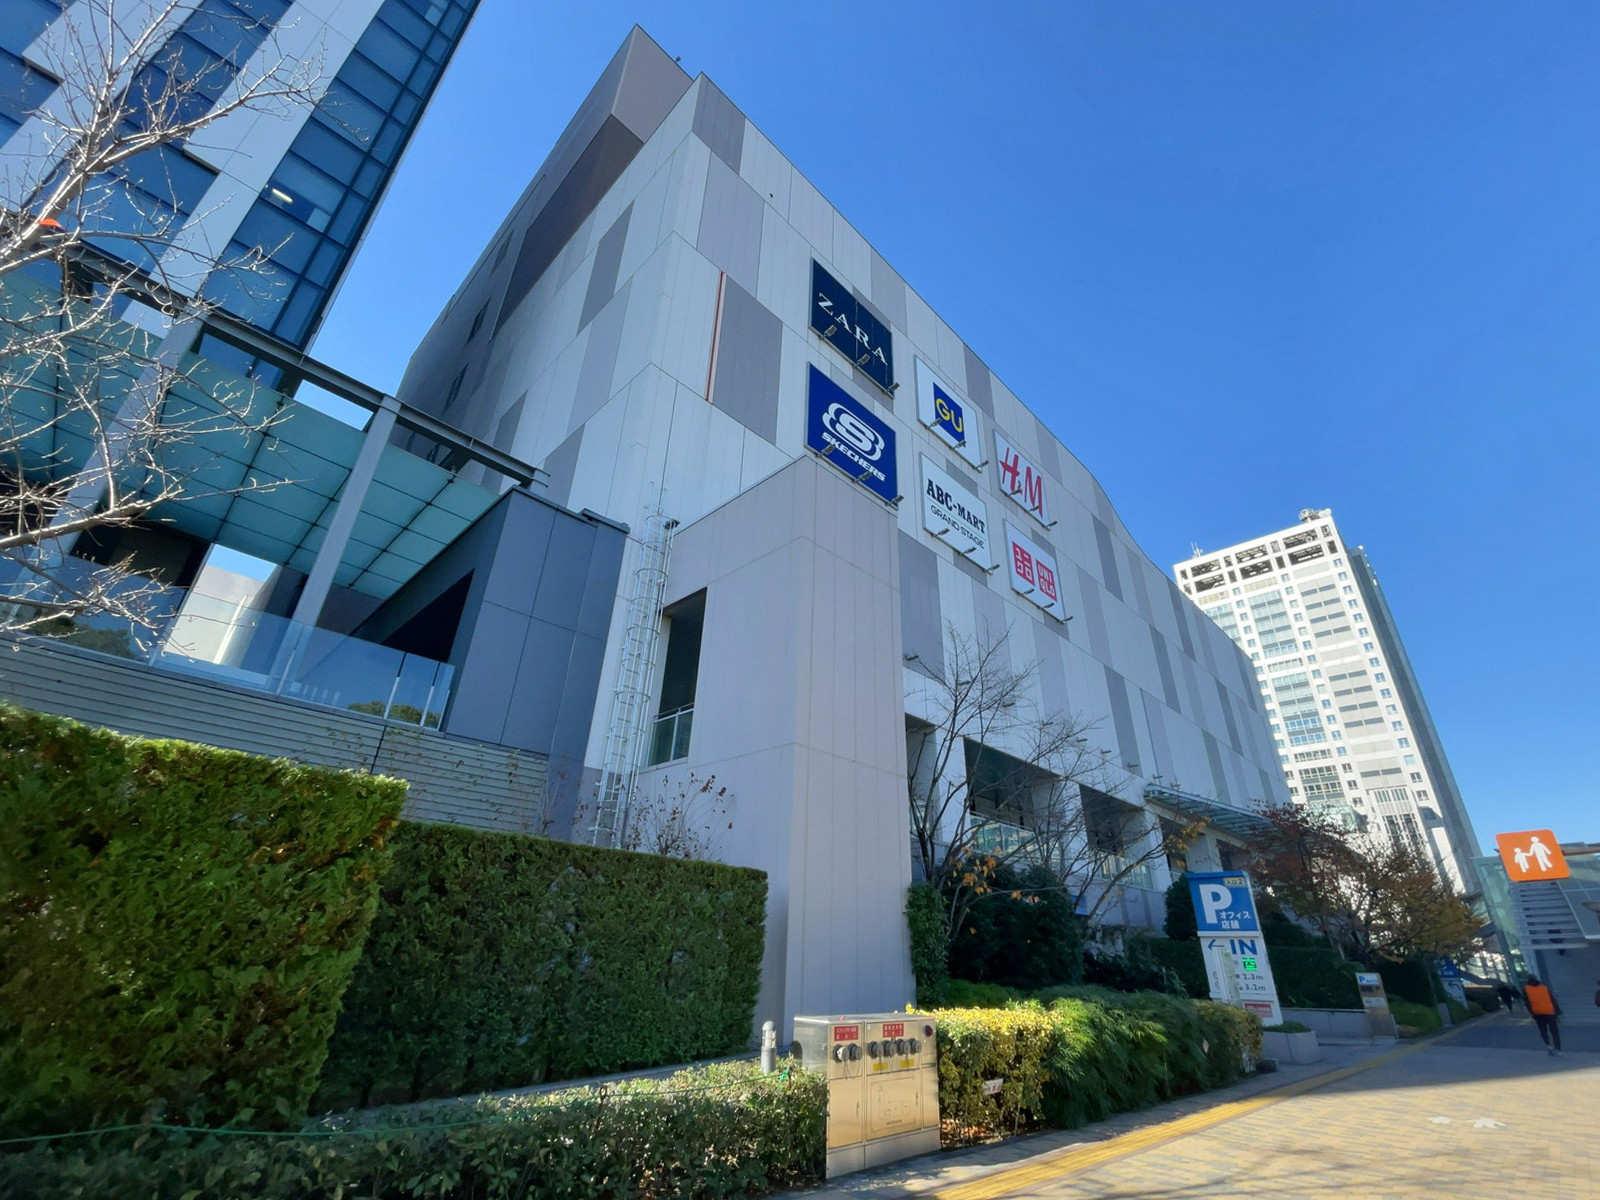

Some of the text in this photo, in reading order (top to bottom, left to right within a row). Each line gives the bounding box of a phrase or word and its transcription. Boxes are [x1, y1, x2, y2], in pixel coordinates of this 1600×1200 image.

[817, 292, 889, 366] ZARA
[935, 398, 963, 433] GU
[821, 431, 886, 482] SKECHERS
[999, 446, 1043, 520] H&M
[926, 478, 985, 534] ABC-MART
[930, 504, 985, 549] GRAND STAGE
[1199, 884, 1232, 924] P
[1220, 911, 1251, 919] オフィス
[1230, 938, 1258, 955] IN
